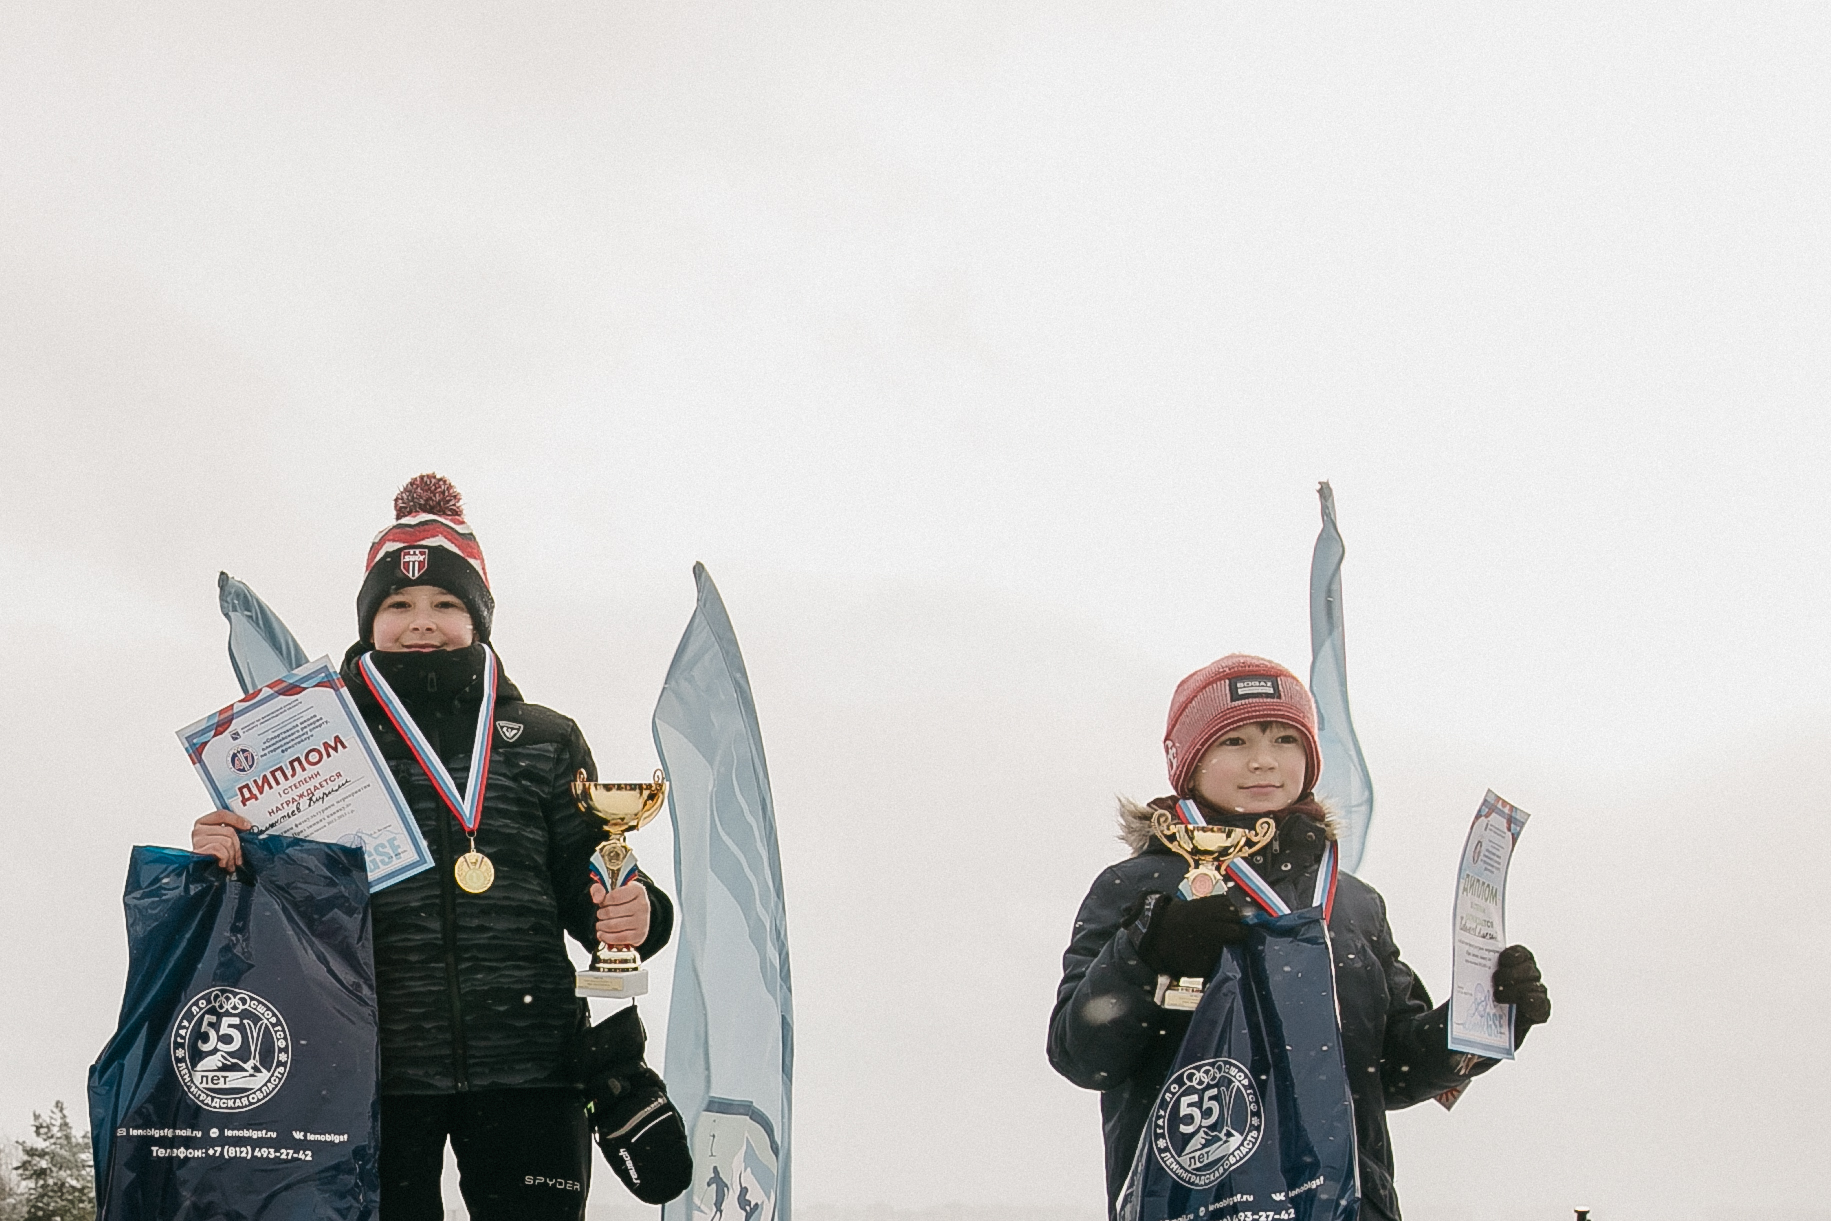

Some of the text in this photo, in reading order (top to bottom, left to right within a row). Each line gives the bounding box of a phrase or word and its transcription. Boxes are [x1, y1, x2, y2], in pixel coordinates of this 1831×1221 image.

[237, 734, 348, 807] ДИПЛОМ
[282, 771, 321, 796] СТЕПЕНИ
[267, 771, 343, 817] НАГРАЖДАЕТСЯ
[1461, 872, 1498, 906] ДИПЛОМ
[177, 1019, 190, 1043] ГАУ
[191, 999, 207, 1016] ЛО
[250, 1000, 277, 1025] СШОР
[197, 1014, 243, 1052] 55
[199, 1074, 230, 1086] лет
[248, 1066, 286, 1103] ОБЛАСТЬ
[1156, 1108, 1166, 1134] ГАУ
[1164, 1083, 1179, 1102] ЛО
[1179, 1087, 1220, 1134] 55
[150, 1146, 313, 1161] Телефон: +7 (812) 493-27-42
[1161, 1131, 1259, 1186] ЛЕНИНГРАДСКАЯ ОБЛАСТЬ
[524, 1175, 581, 1192] SPYDER
